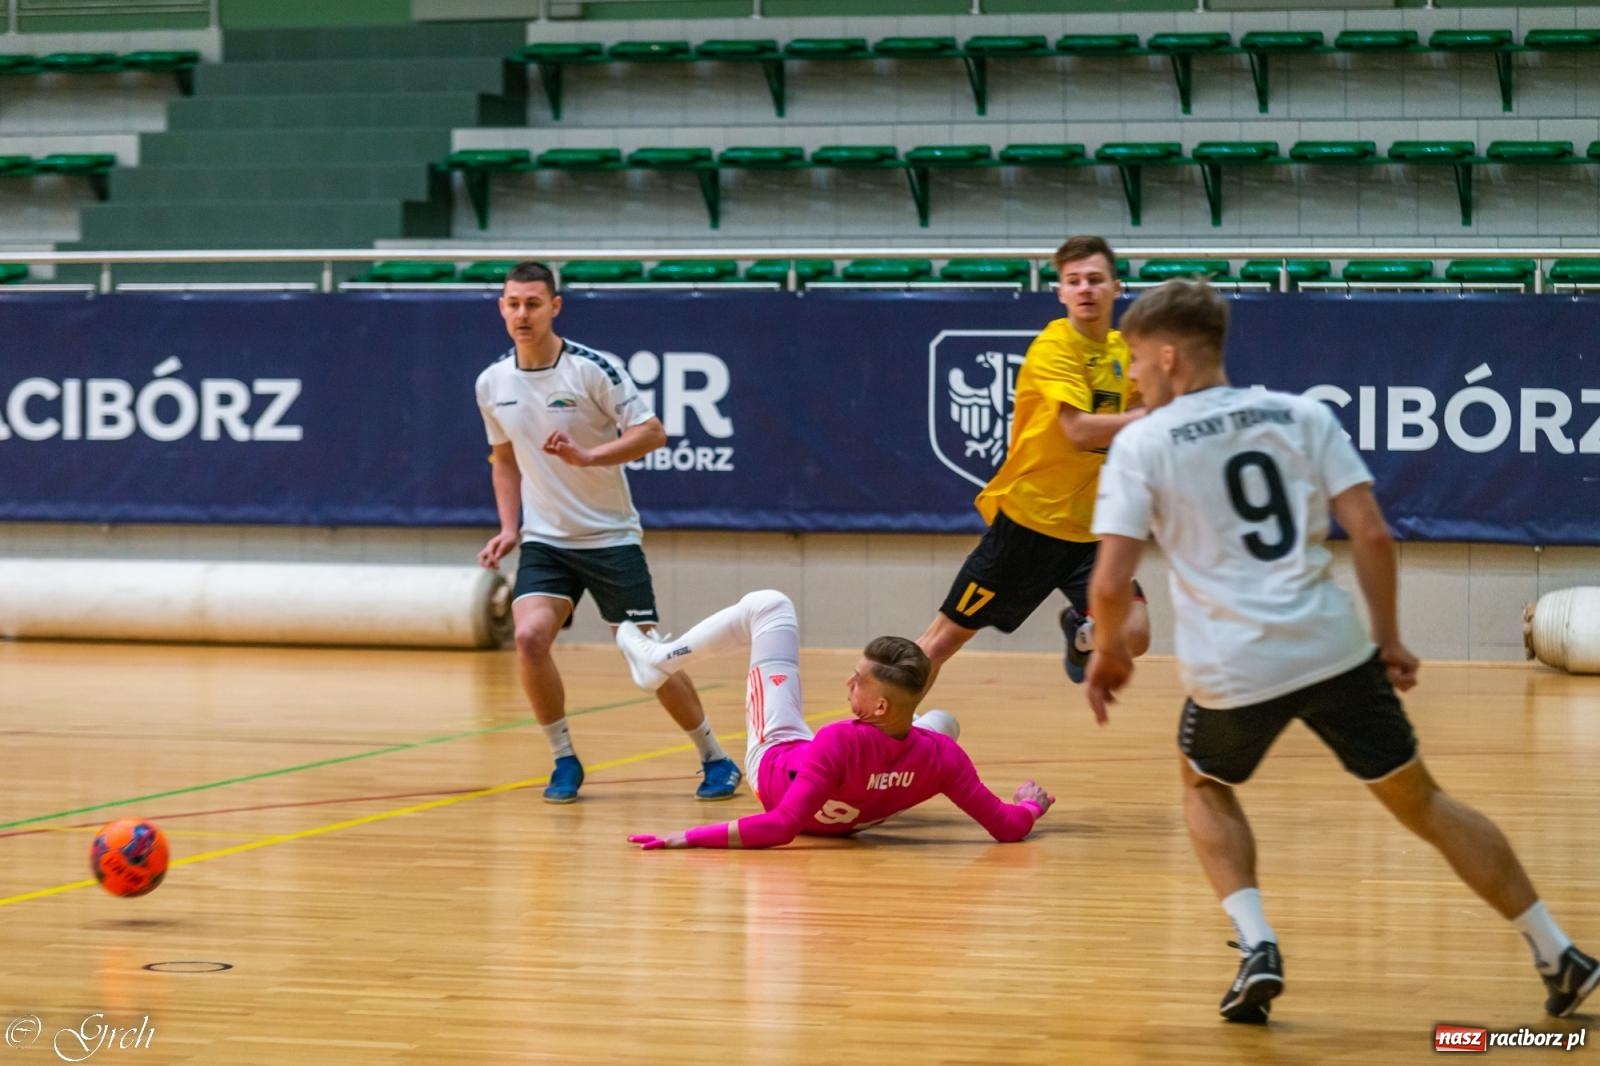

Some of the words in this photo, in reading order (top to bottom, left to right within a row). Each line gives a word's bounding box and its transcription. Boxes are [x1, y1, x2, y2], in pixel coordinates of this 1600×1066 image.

[0, 356, 303, 442] CIBÓRZ
[1250, 362, 1600, 454] IBÓR
[1223, 450, 1297, 562] 9
[956, 582, 996, 617] 17
[814, 799, 880, 828] 9
